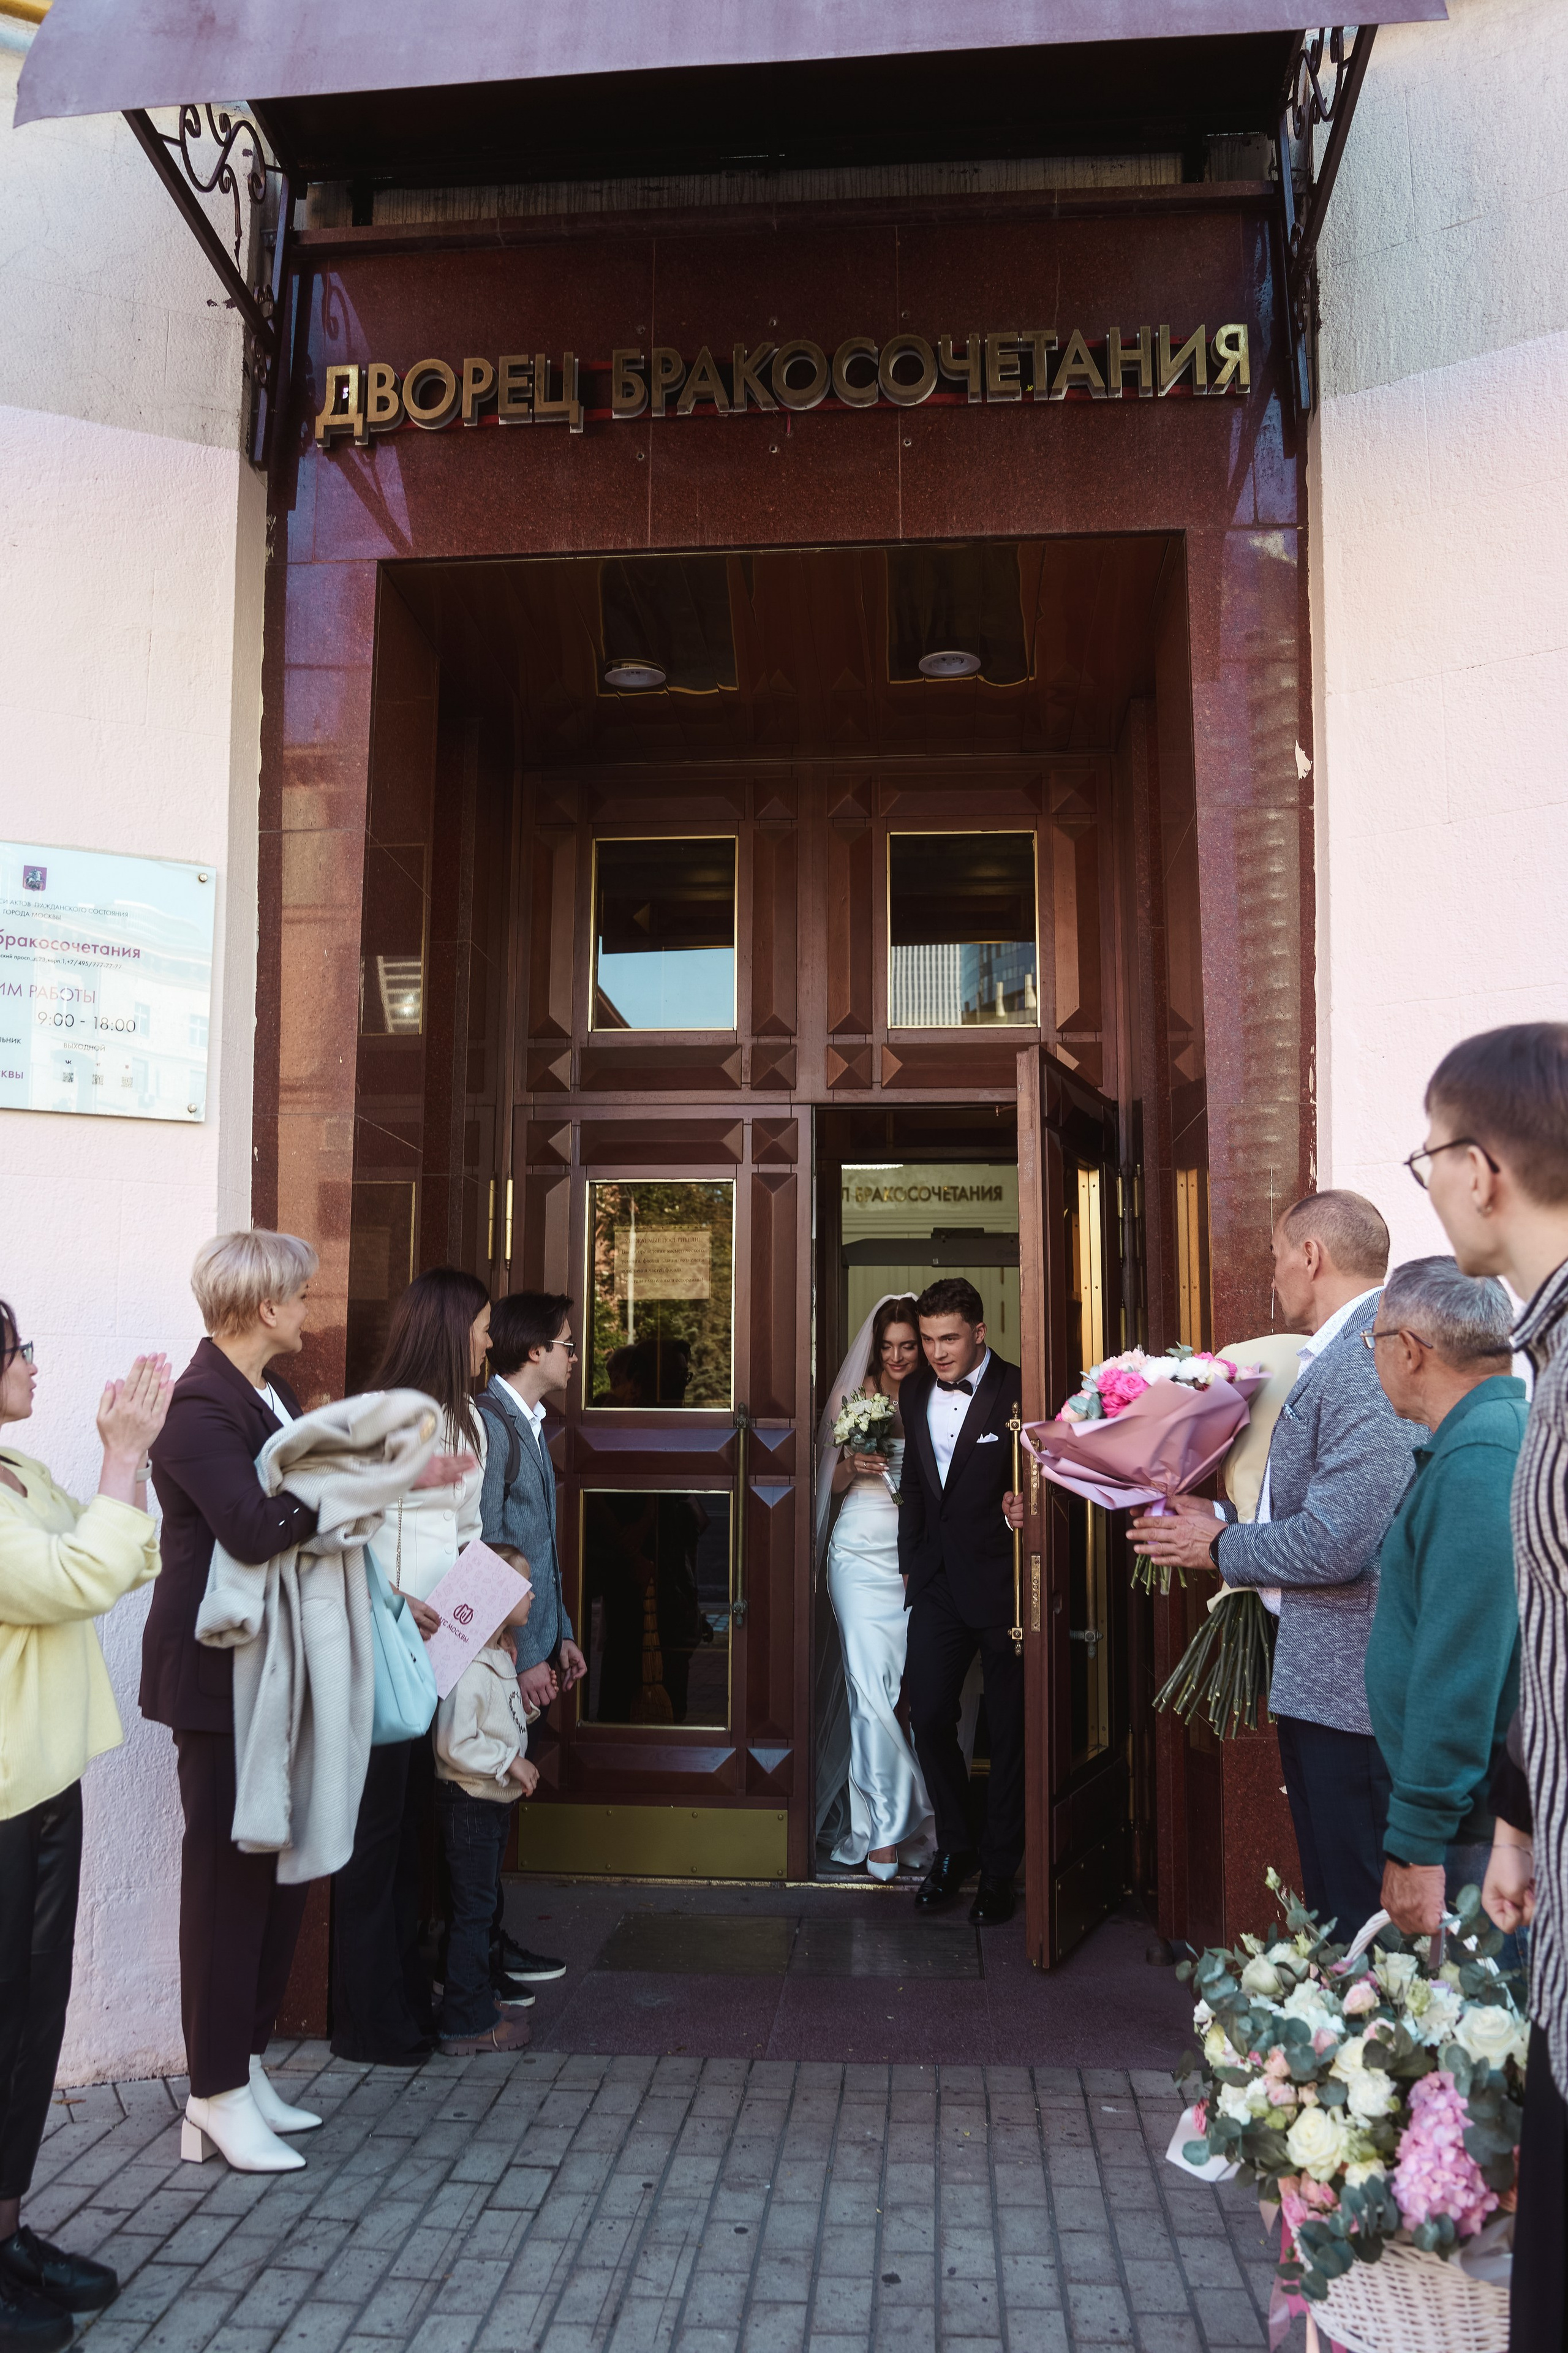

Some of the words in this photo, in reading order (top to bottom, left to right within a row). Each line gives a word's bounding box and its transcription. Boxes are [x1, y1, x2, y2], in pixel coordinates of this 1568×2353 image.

[315, 352, 584, 448] ДВОРЕЦ
[611, 323, 1251, 419] БРАКОСОЧЕТАНИЯ
[3, 908, 30, 917] ГОРОДА
[34, 902, 86, 913] ГРАЖДАНСКОГО
[88, 908, 129, 917] СОСТОЯНИЯ
[29, 984, 96, 1003] РАБОТЫ
[37, 1011, 75, 1027] 9:00
[94, 1016, 136, 1033] 18:00
[855, 1185, 1003, 1202] БРАКОСОЧЕТАНИЯ
[447, 1623, 469, 1643] МОСКВЫ
